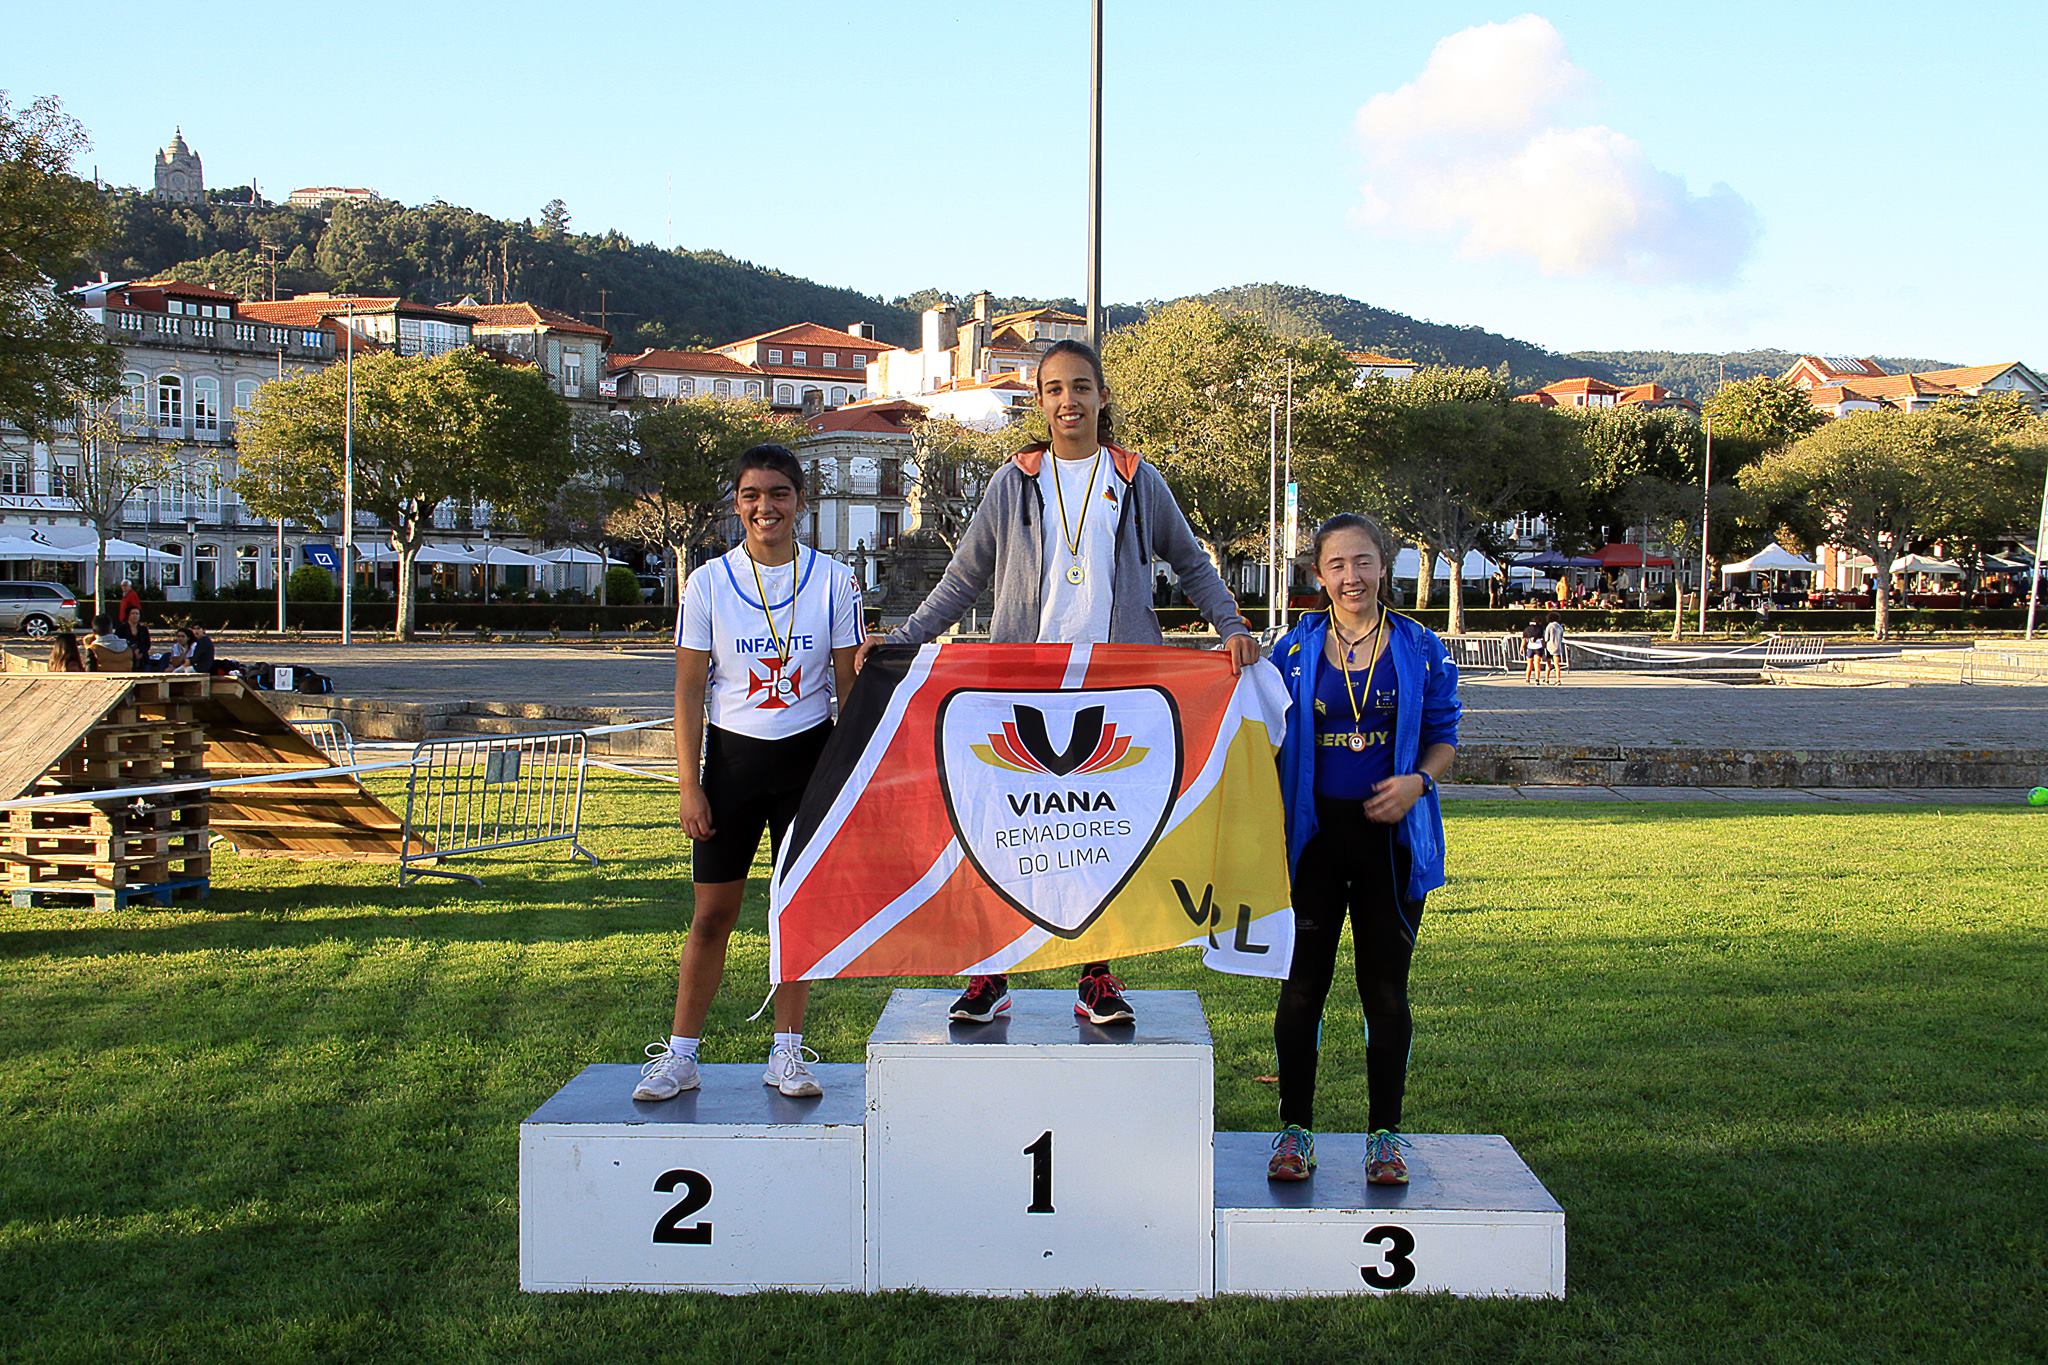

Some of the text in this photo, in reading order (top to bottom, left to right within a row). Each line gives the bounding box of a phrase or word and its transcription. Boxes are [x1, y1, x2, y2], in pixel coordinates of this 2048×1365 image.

[736, 635, 813, 653] INFANTE
[1006, 790, 1117, 817] VIANA
[995, 820, 1131, 849] REMADORES
[1018, 846, 1111, 875] DO LIMA
[1023, 1130, 1055, 1214] 1
[652, 1169, 713, 1245] 2
[1359, 1225, 1417, 1291] 3
